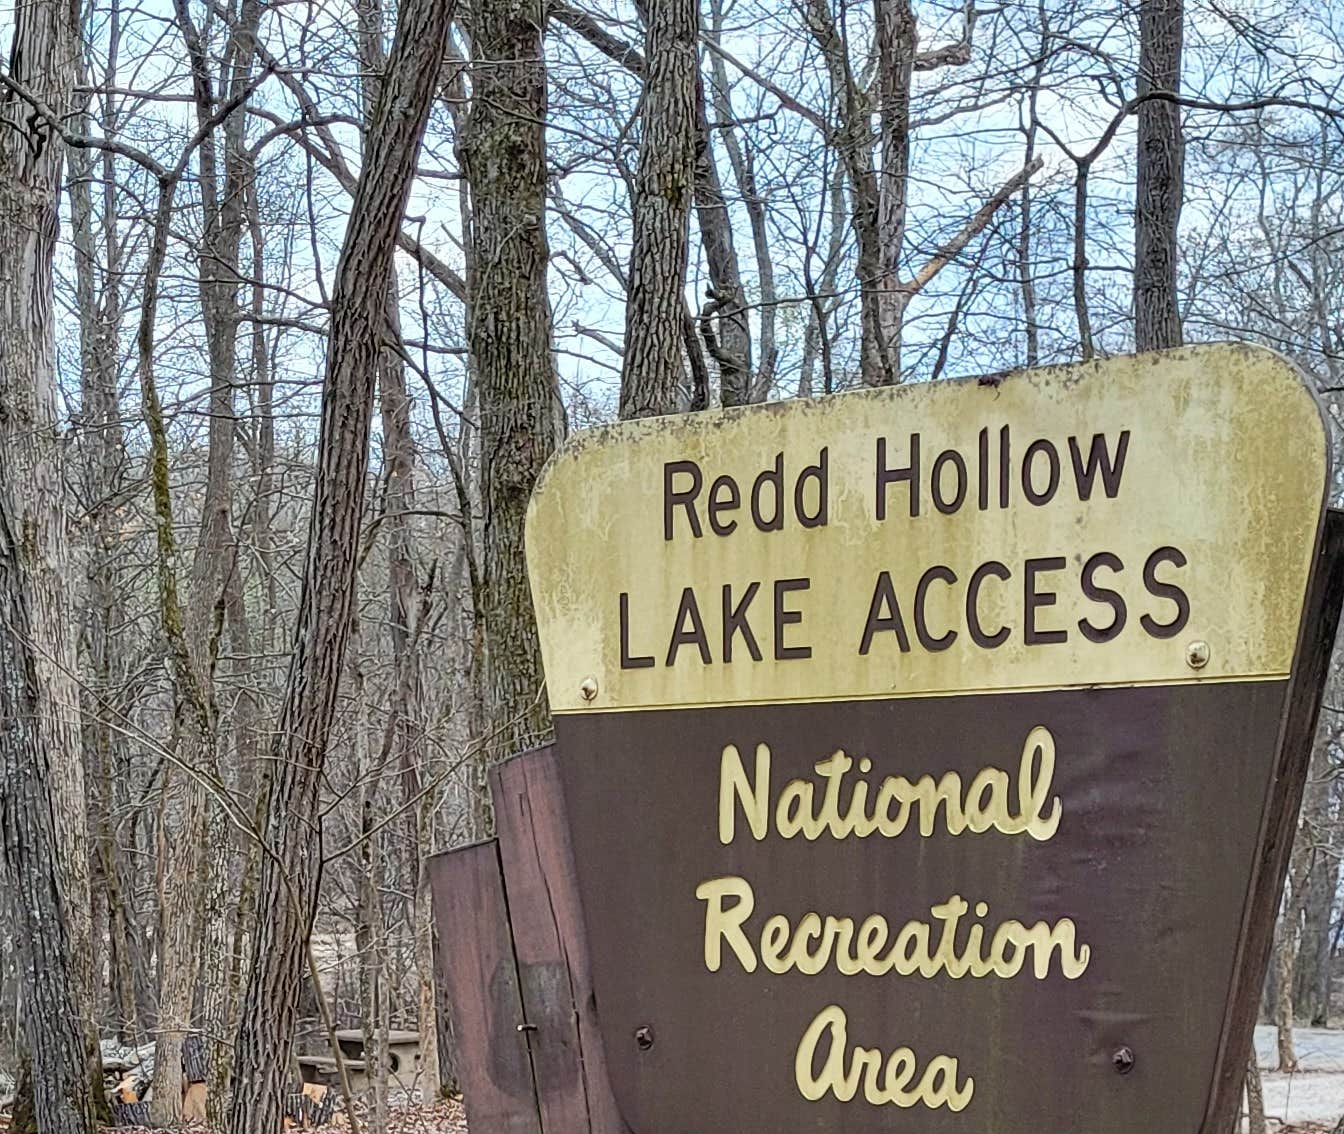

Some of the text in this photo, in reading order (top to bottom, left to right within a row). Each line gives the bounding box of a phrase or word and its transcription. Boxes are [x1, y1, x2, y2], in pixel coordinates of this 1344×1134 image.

[663, 424, 1132, 541] Redd Hollow
[618, 545, 1192, 671] LAKE ACCESS
[719, 725, 1062, 845] National
[695, 875, 1091, 980] Recreation
[794, 1004, 974, 1112] Area
